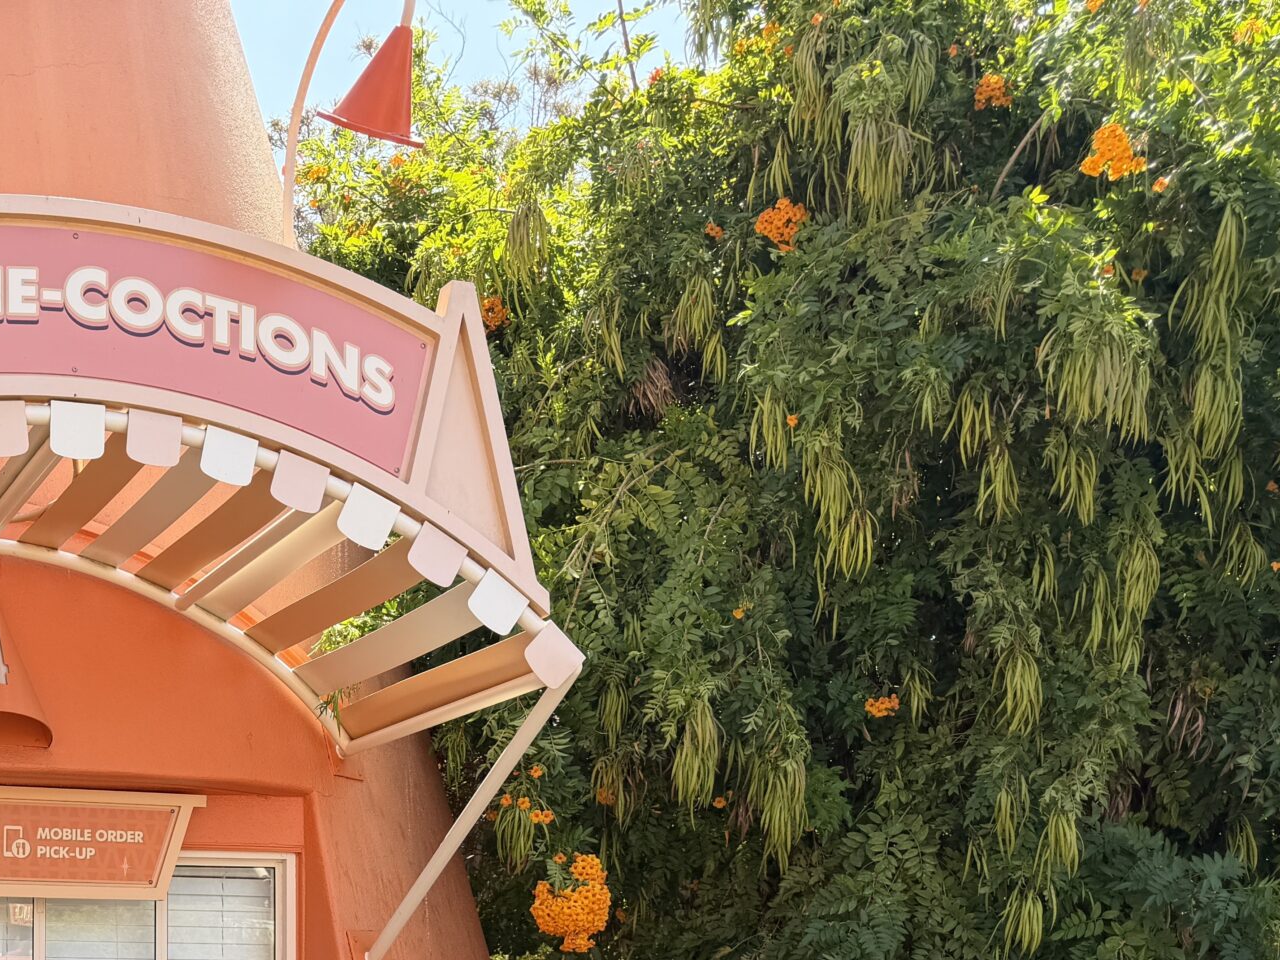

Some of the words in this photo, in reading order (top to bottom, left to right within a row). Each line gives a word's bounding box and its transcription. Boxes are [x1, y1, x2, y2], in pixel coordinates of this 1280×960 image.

[36, 826, 93, 844] MOBILE
[95, 829, 145, 845] ORDER
[36, 844, 97, 861] PICK-UP
